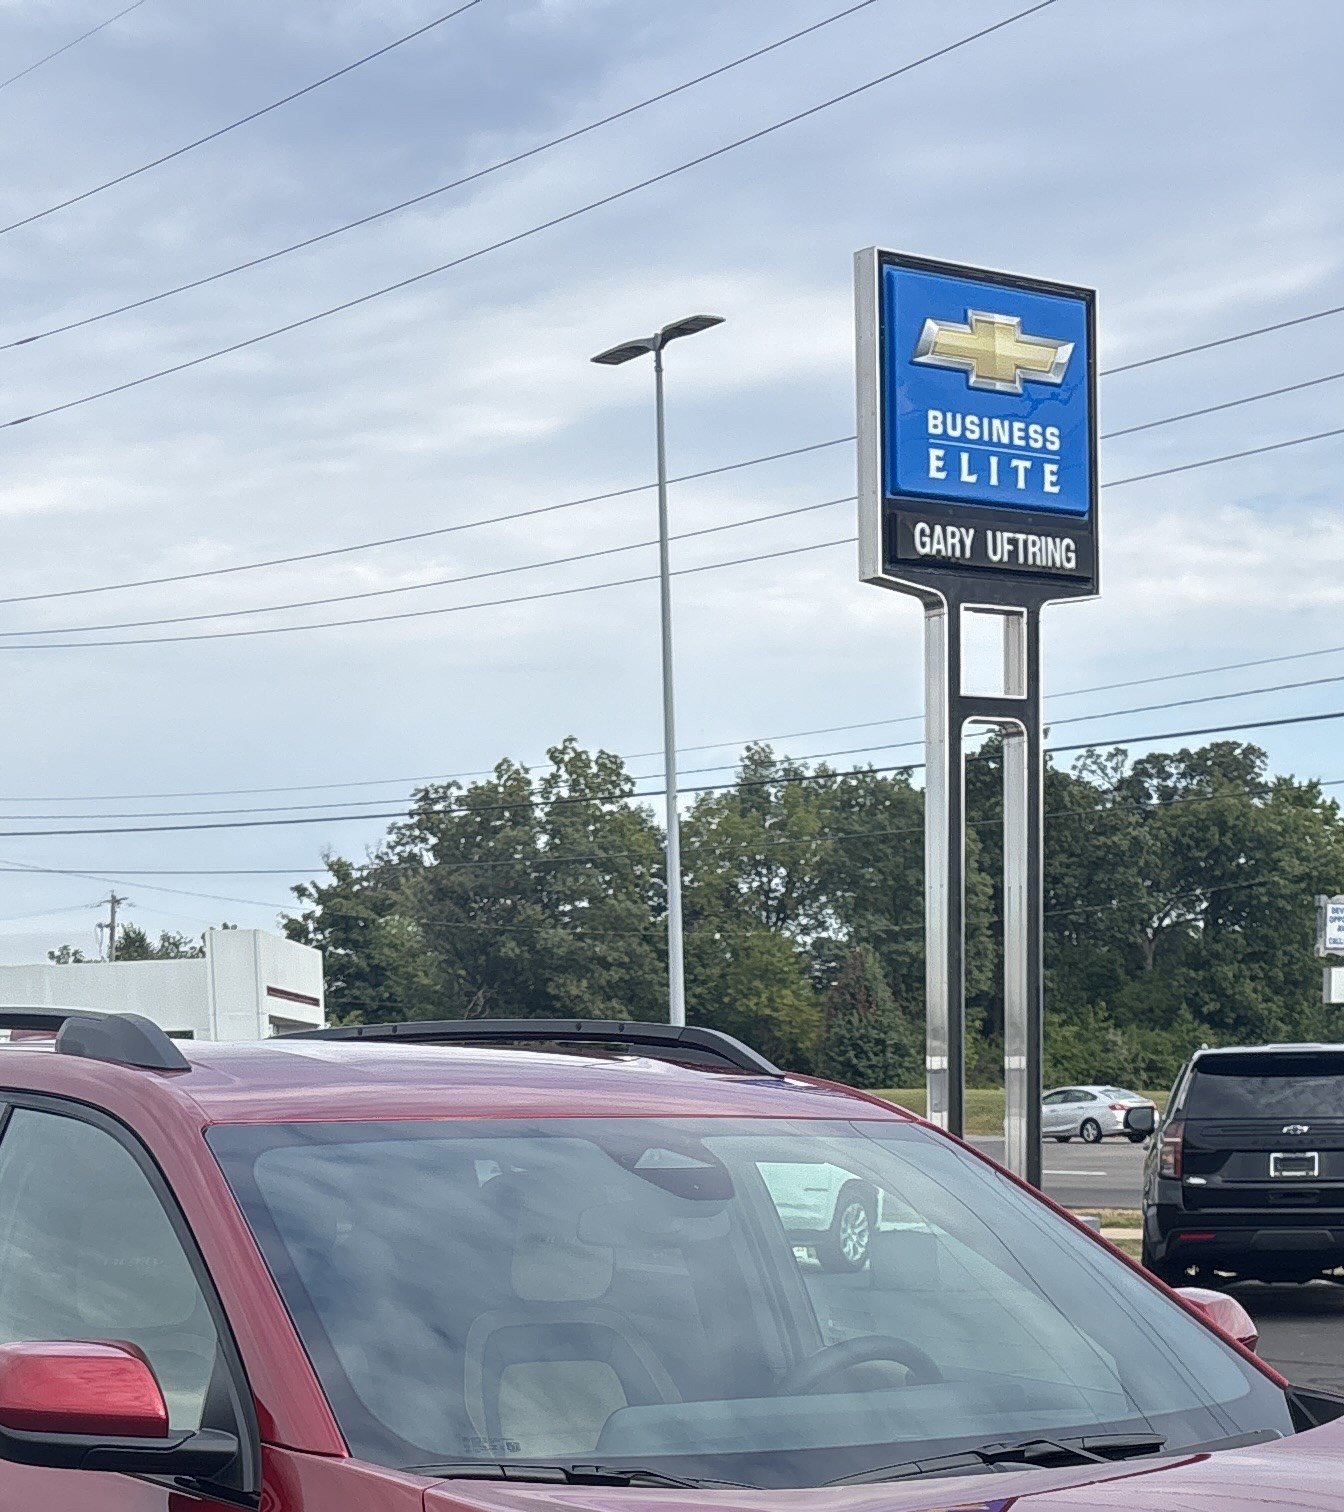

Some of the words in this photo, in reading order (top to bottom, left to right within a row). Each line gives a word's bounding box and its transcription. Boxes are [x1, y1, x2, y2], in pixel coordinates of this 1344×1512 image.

[927, 409, 1060, 450] BUSINESS
[928, 448, 1060, 494] ELITE
[913, 521, 975, 559] GARY
[986, 530, 1076, 570] UFTRING
